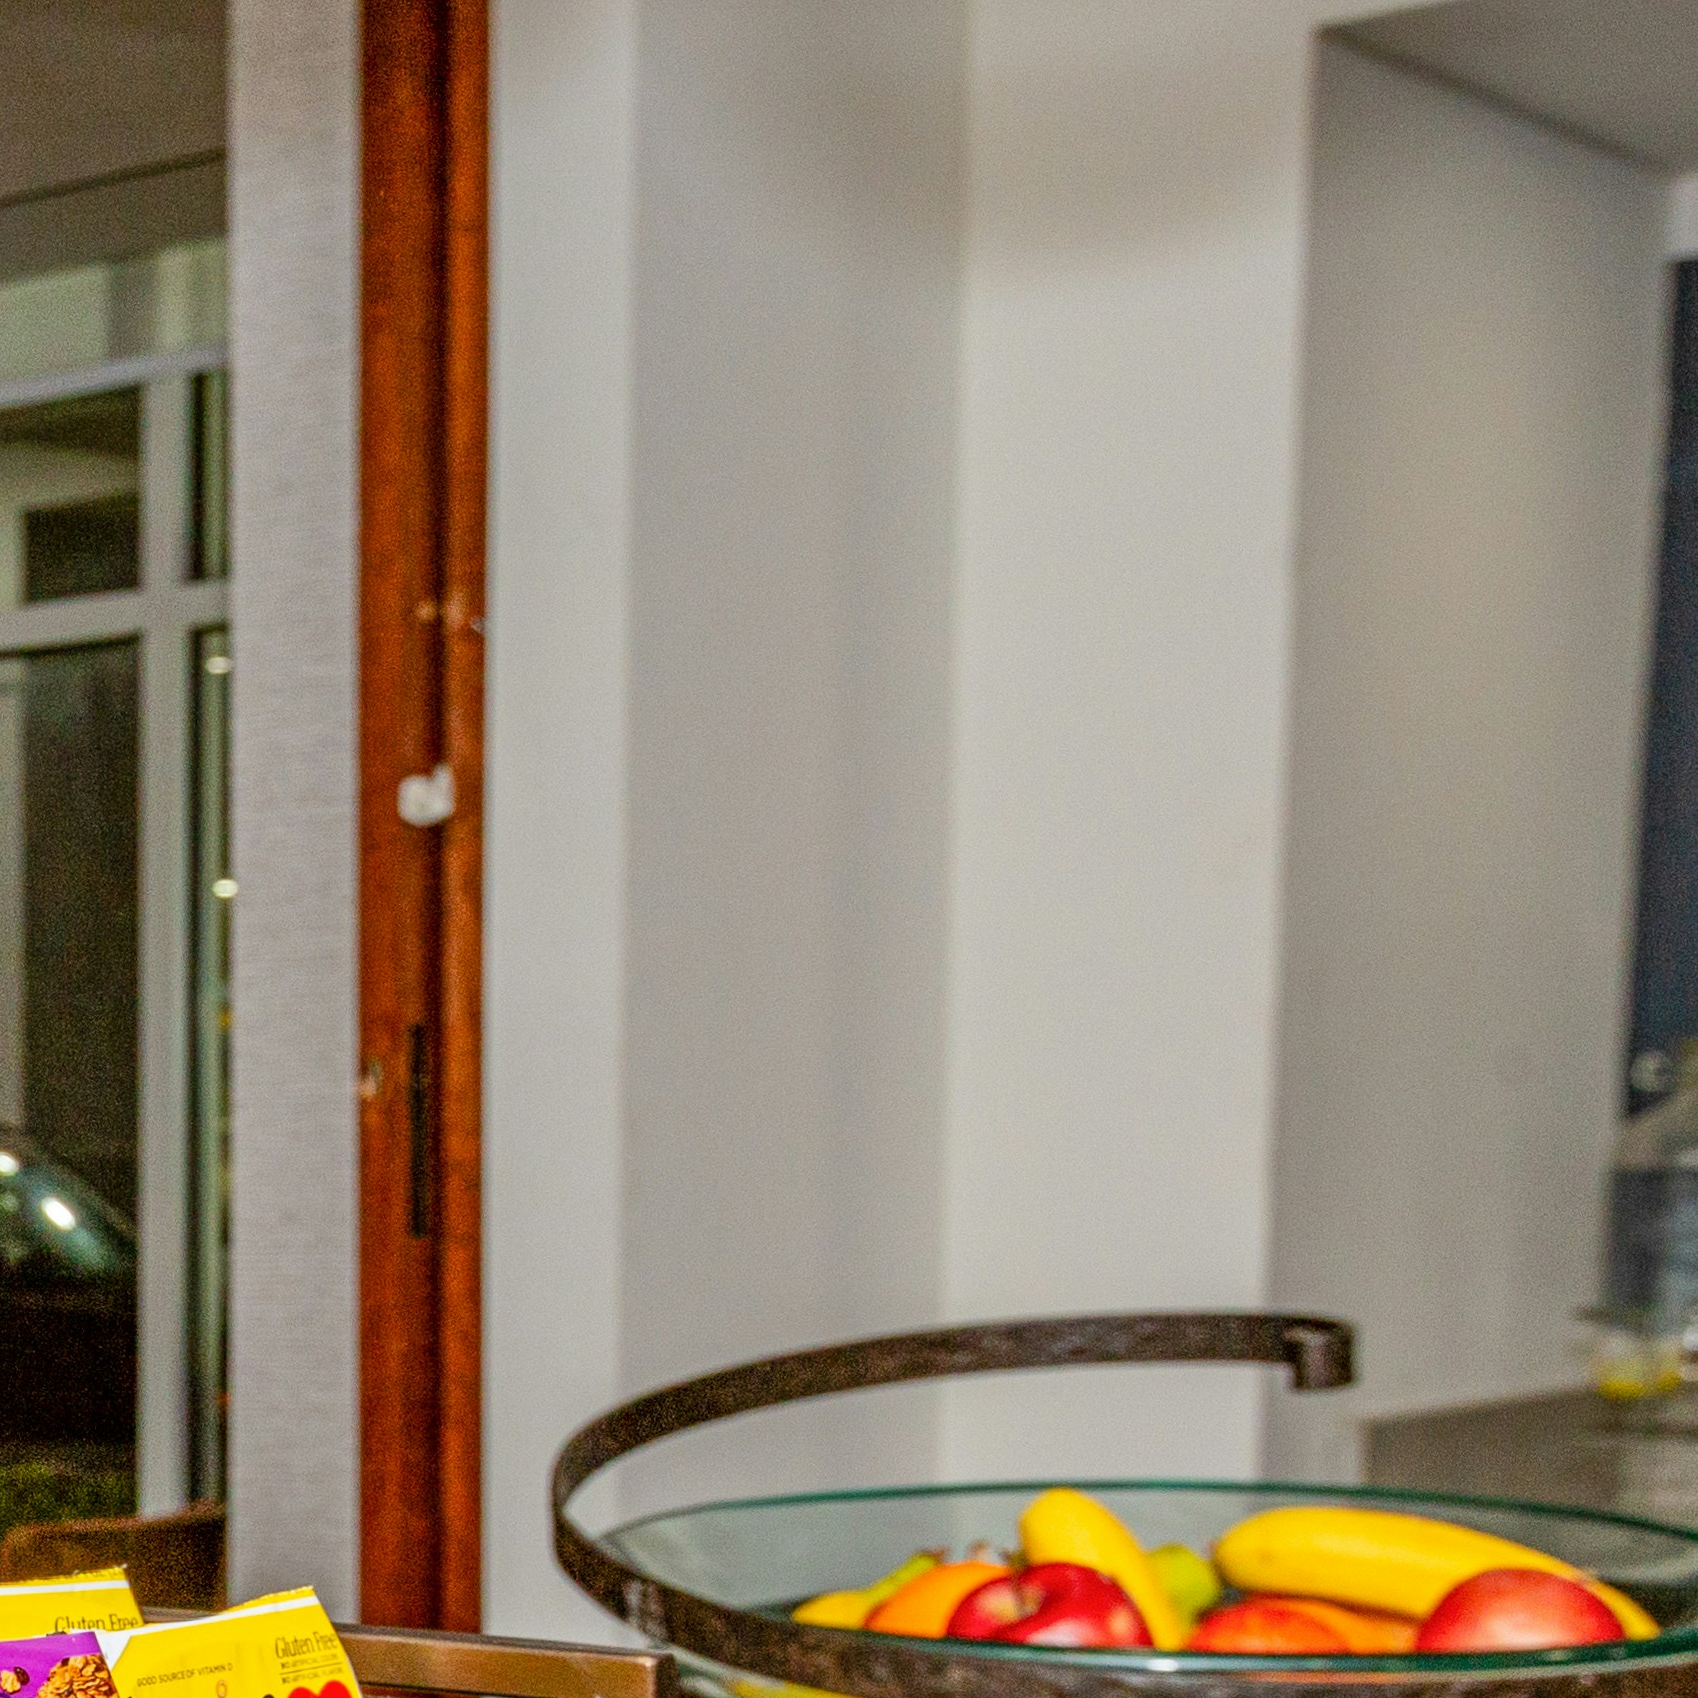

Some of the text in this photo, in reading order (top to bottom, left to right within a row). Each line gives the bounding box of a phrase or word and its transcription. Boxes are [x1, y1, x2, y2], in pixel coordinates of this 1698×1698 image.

[275, 1630, 339, 1660] Gluten Free
[136, 1661, 233, 1688] GOOD SOURCE OF VITAMIN D
